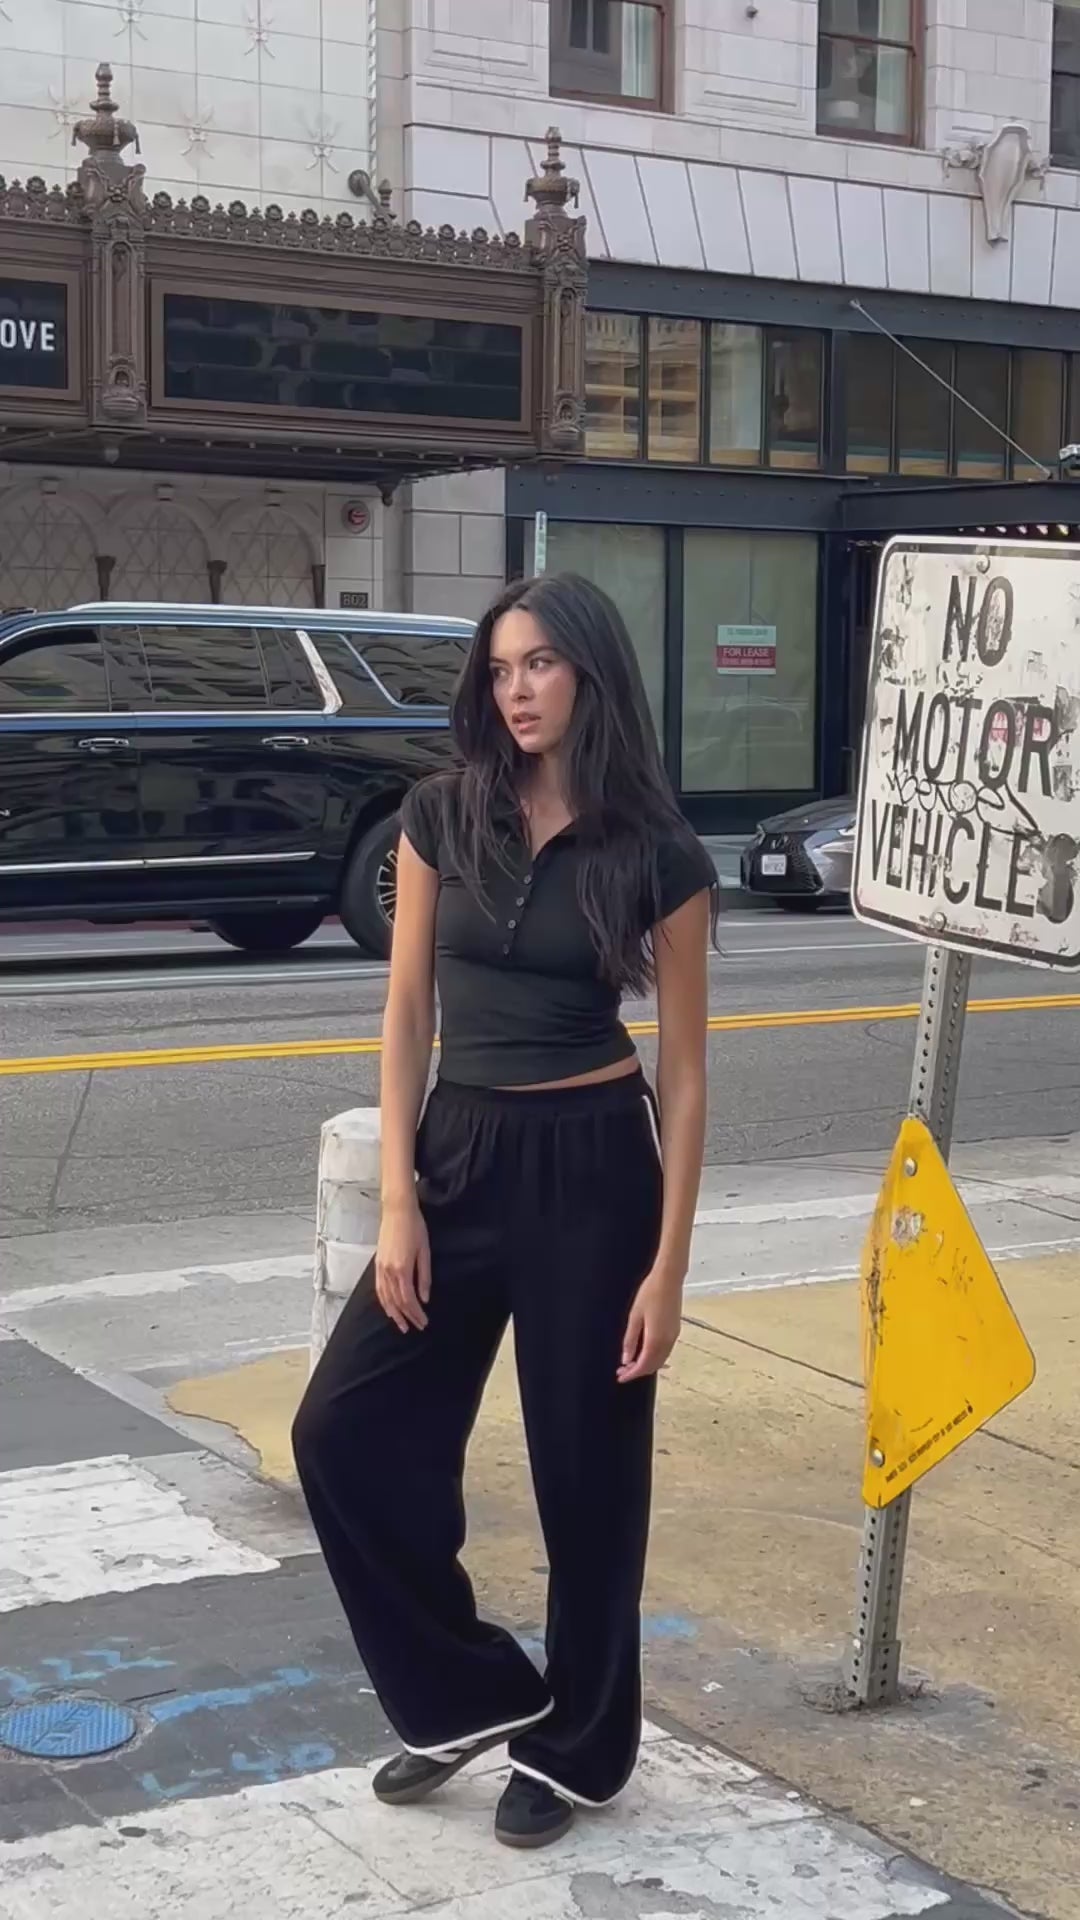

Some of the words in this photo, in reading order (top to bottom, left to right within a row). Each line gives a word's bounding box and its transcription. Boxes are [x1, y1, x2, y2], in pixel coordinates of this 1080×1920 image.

[0, 318, 55, 351] OVE
[722, 647, 741, 657] FOR
[743, 647, 769, 657] LEASE
[942, 575, 1014, 667] NO
[892, 689, 1056, 798] MOTOR
